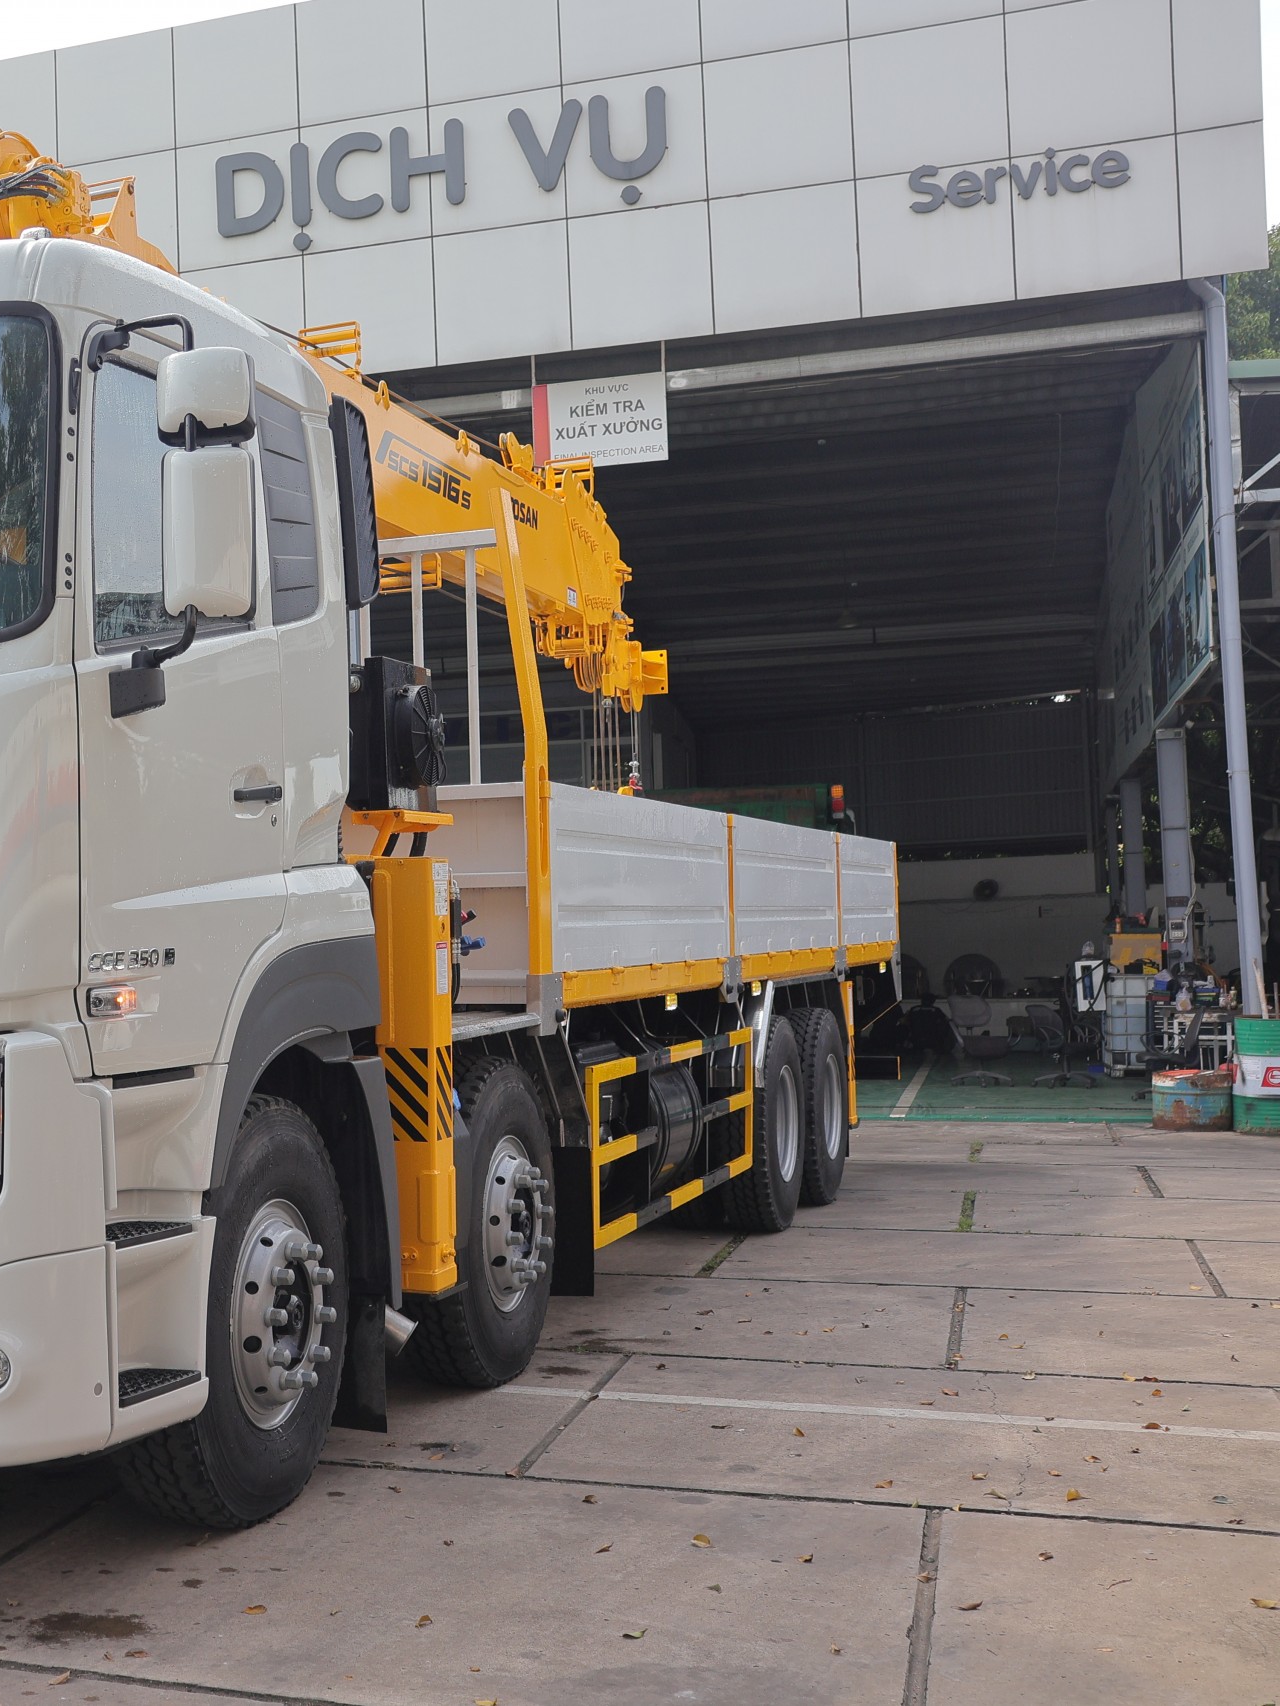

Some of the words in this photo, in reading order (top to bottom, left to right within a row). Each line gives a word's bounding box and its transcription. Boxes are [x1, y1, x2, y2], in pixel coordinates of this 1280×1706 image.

[215, 118, 466, 251] DỊCH
[508, 86, 667, 204] VỤ
[908, 147, 1131, 213] Service
[585, 386, 605, 395] KHU
[569, 399, 608, 418] KIỂM
[612, 399, 645, 414] TRA
[555, 421, 597, 440] XUẤT
[602, 416, 663, 436] XƯỞNG
[639, 444, 664, 454] AREA
[511, 496, 538, 530] OSAN
[127, 948, 160, 970] 350
